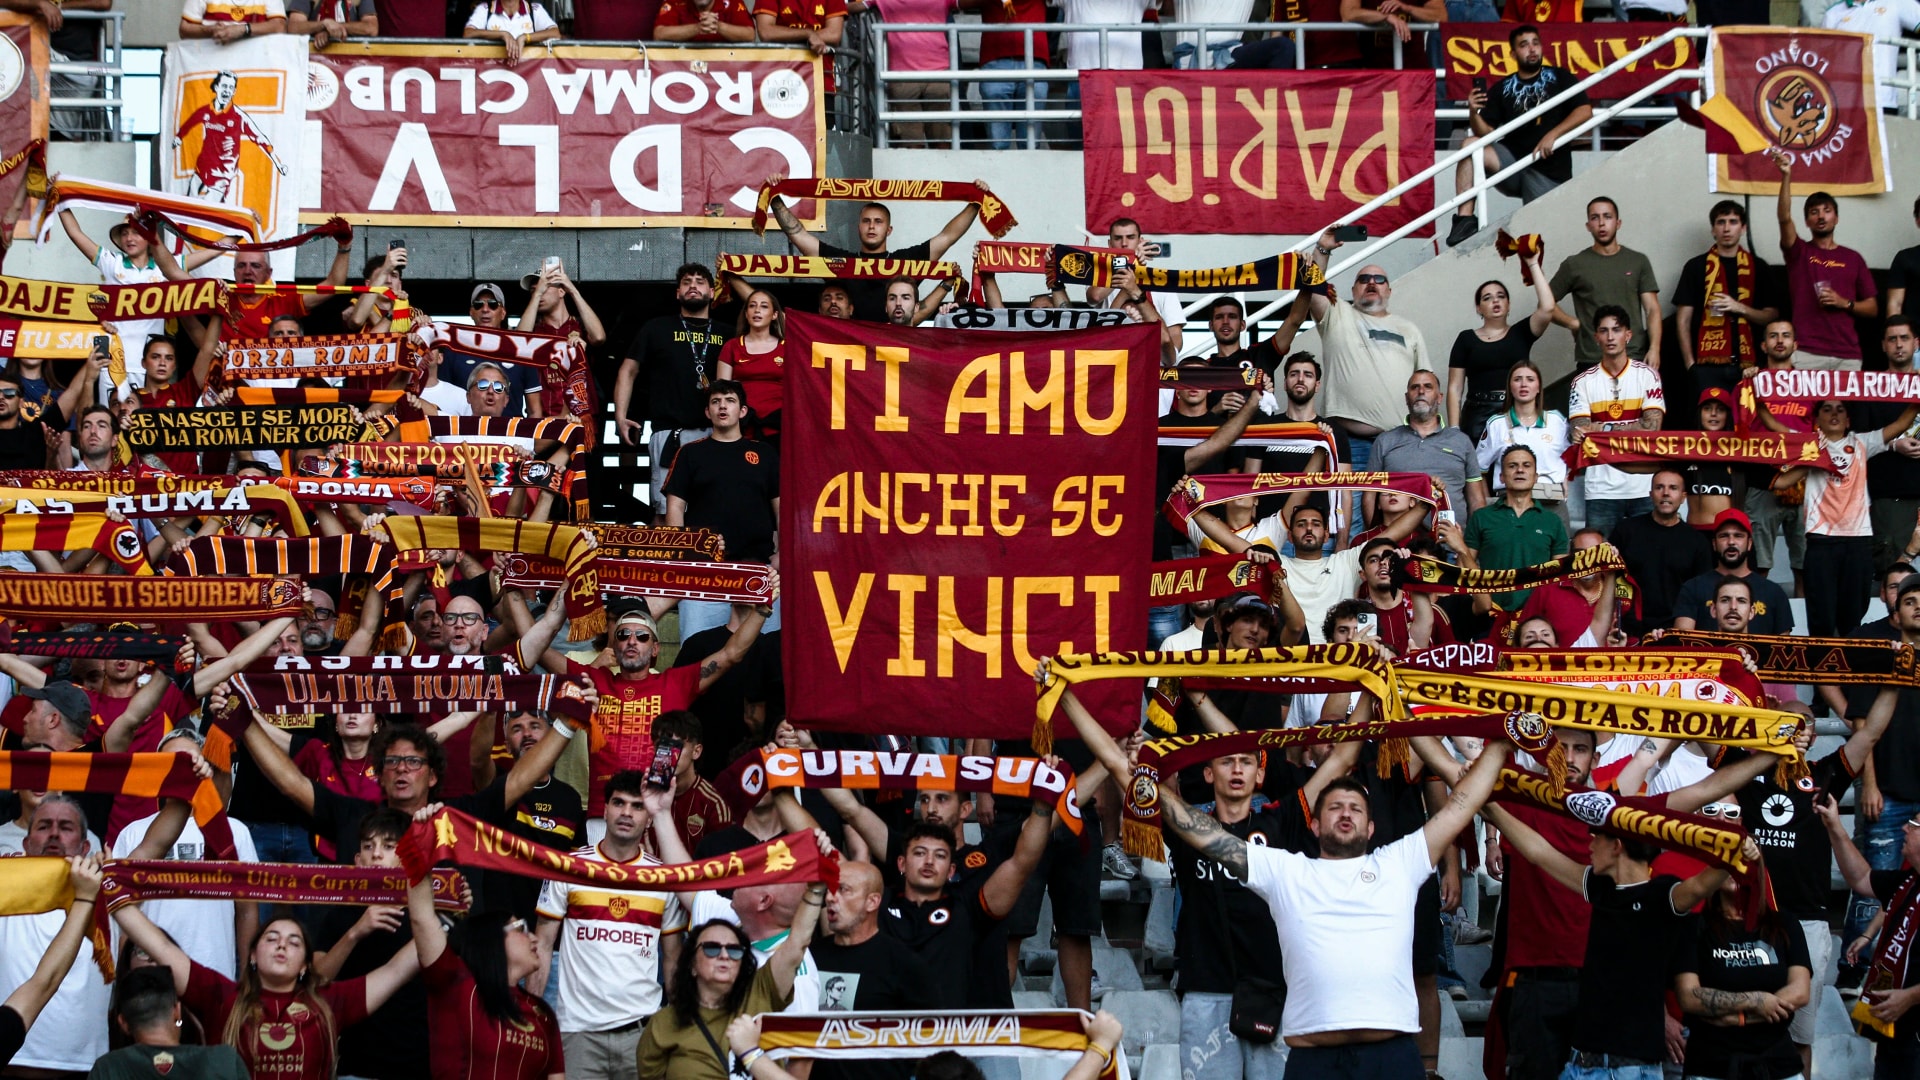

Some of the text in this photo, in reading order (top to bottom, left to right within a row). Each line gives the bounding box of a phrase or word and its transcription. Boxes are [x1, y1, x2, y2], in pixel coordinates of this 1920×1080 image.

[344, 65, 529, 114] CLUB
[542, 67, 753, 116] ROMA
[724, 254, 953, 276] DAJE ROMA
[978, 245, 1014, 267] NUN
[1018, 247, 1040, 268] SE
[1178, 262, 1259, 287] ROMA
[0, 279, 216, 317] DAJE ROMA
[1008, 308, 1128, 330] roma
[22, 330, 51, 349] TU
[1700, 340, 1727, 351] 1927
[314, 345, 388, 366] ROMA
[812, 342, 1129, 436] TI AMO
[1776, 370, 1831, 398] SONO
[1834, 370, 1860, 397] LA
[1864, 371, 1920, 399] ROMA
[158, 411, 235, 428] NASCE
[242, 411, 256, 426] E
[262, 410, 292, 426] SE
[164, 429, 190, 446] LA
[195, 428, 253, 446] ROMA
[260, 427, 299, 444] NER
[305, 425, 358, 443] CORE
[1609, 432, 1787, 459] NUN SE PÒ SPIEGÀ
[386, 445, 411, 464] SE
[450, 444, 523, 465] SPIEG
[107, 487, 250, 513] ROMA
[297, 481, 394, 498] ROMA
[813, 472, 1125, 537] ANCHE SE
[606, 529, 693, 546] ROMA
[620, 565, 659, 583] Ultrà
[663, 570, 711, 587] Curva
[712, 573, 743, 589] Sud
[1151, 568, 1207, 596] MAI
[1456, 567, 1516, 586] FORZA
[109, 581, 135, 608] TI
[813, 571, 1120, 679] VINCI
[1510, 655, 1723, 674] DI LONDRA
[413, 674, 504, 701] ROMA
[1638, 674, 1672, 682] ONORE
[598, 705, 661, 715] MAI SOLA
[1476, 687, 1567, 720] SOLO
[1659, 710, 1758, 740] ROMA
[621, 725, 652, 734] SOL
[1257, 731, 1307, 748] lupi
[1316, 724, 1388, 743] liguri
[765, 750, 1066, 792] CURVA SUD
[475, 821, 535, 862] NUN
[1754, 828, 1796, 840] RIYADH
[133, 869, 408, 890] Commando Ultrà Curva Su
[576, 926, 653, 948] EUROBET
[1730, 942, 1753, 950] THE
[1713, 948, 1756, 959] NORTH
[1726, 958, 1758, 968] FACE
